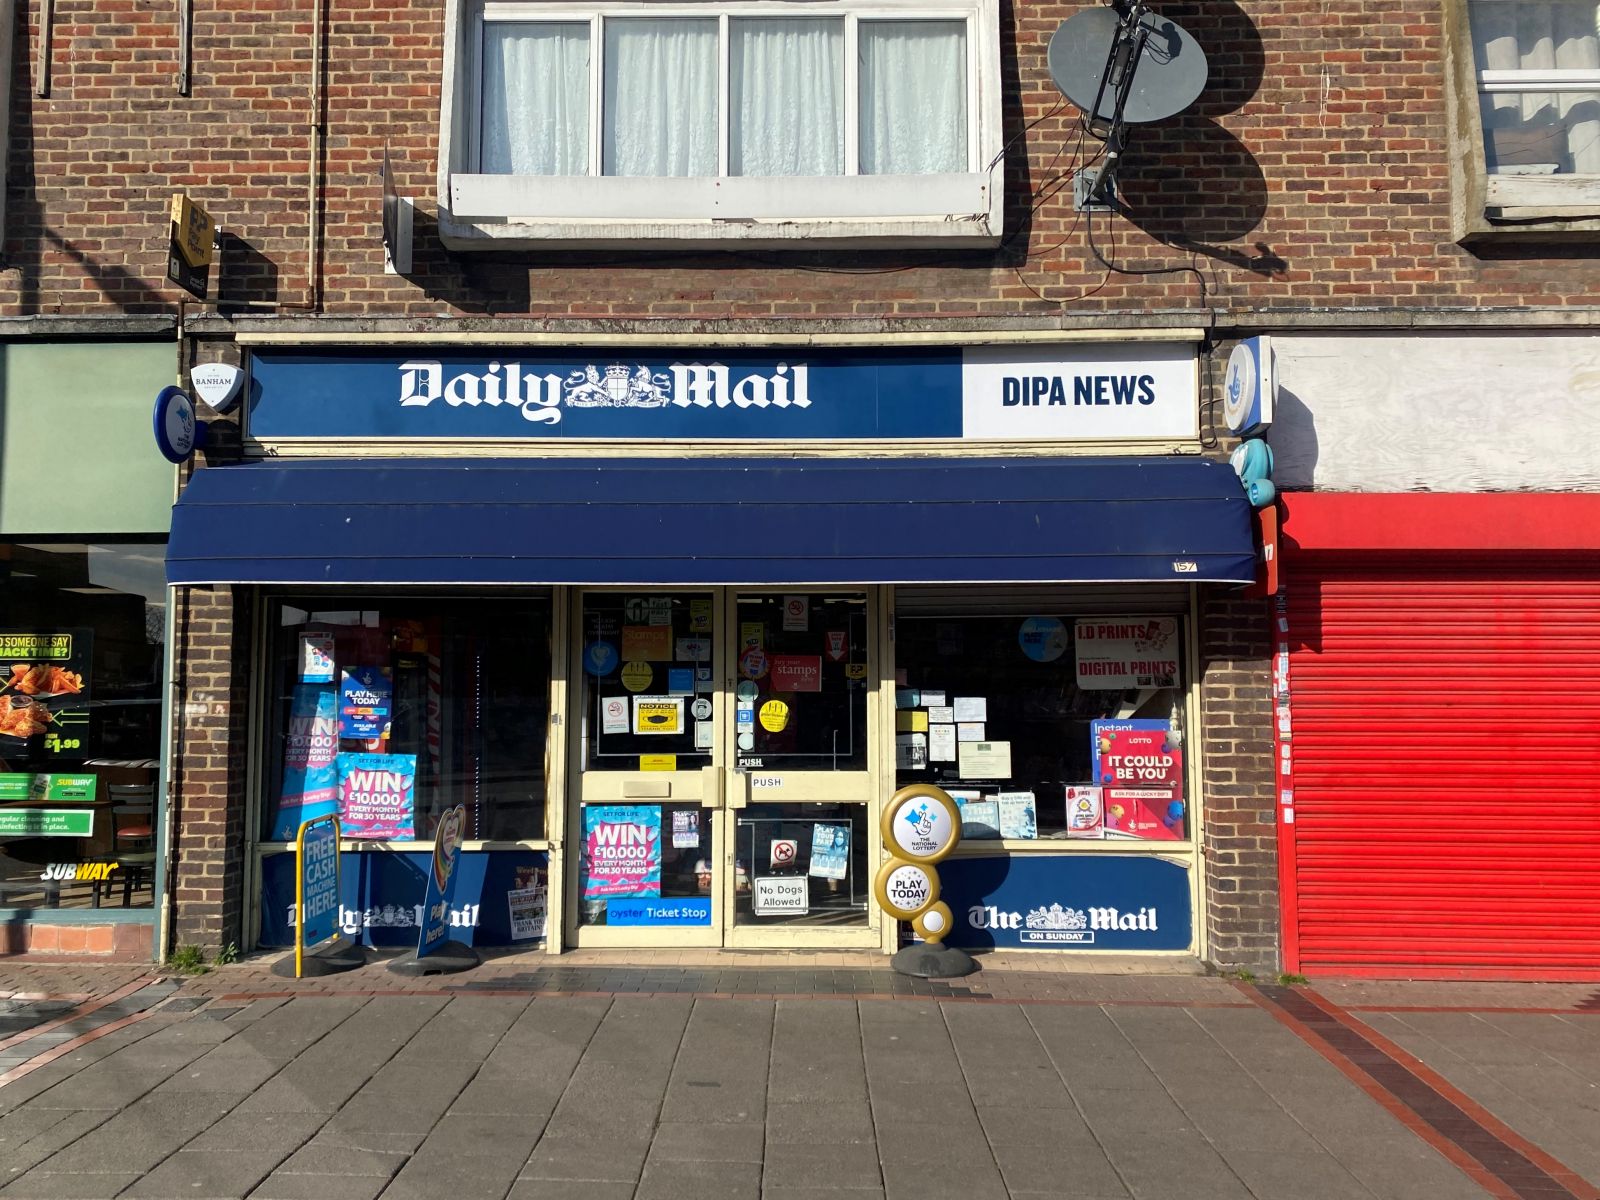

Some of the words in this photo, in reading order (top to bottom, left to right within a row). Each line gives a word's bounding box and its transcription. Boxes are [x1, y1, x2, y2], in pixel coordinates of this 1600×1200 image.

[397, 359, 563, 425] Daily
[669, 361, 813, 409] Mail
[1002, 376, 1067, 406] DIPA
[1074, 374, 1155, 405] NEWS
[1176, 562, 1196, 573] 157
[1078, 625, 1095, 639] I.D
[1098, 624, 1145, 639] PRINTS
[5, 637, 50, 647] SOMEONE
[51, 637, 68, 647] SAY
[30, 648, 67, 656] TIME?
[777, 663, 817, 677] stamps
[1079, 662, 1128, 675] DIGITAL
[1131, 661, 1176, 675] PRINTS
[345, 690, 366, 698] PLAY
[366, 690, 388, 698] HERE
[289, 717, 333, 736] WIN
[44, 739, 80, 753] £1.99
[739, 758, 762, 766] PUSH
[1108, 755, 1121, 767] IT
[1124, 755, 1173, 767] COULD
[1116, 768, 1135, 779] BE
[349, 771, 401, 792] WIN
[753, 779, 781, 787] PUSH
[349, 792, 401, 806] £10,000
[21, 815, 50, 824] cleaning
[594, 825, 647, 845] WIN
[818, 826, 834, 834] PLAY
[816, 838, 833, 846] PART
[306, 835, 334, 864] FREE
[594, 846, 647, 860] £10,000
[40, 861, 119, 880] SUBWAY
[306, 856, 335, 883] CASH
[306, 876, 336, 897] MACHINE
[760, 885, 774, 894] No
[778, 884, 803, 897] Dogs
[895, 880, 922, 889] PLAY
[891, 889, 927, 898] TODAY
[307, 888, 336, 919] HERE
[763, 896, 801, 907] Allowed
[430, 901, 448, 922] Play
[610, 909, 643, 919] oyster
[646, 907, 680, 917] Ticket
[682, 907, 707, 919] Stop
[968, 905, 1023, 930] The
[1088, 905, 1158, 931] Mail
[426, 923, 444, 944] here!
[1046, 932, 1085, 940] SUNDAY
